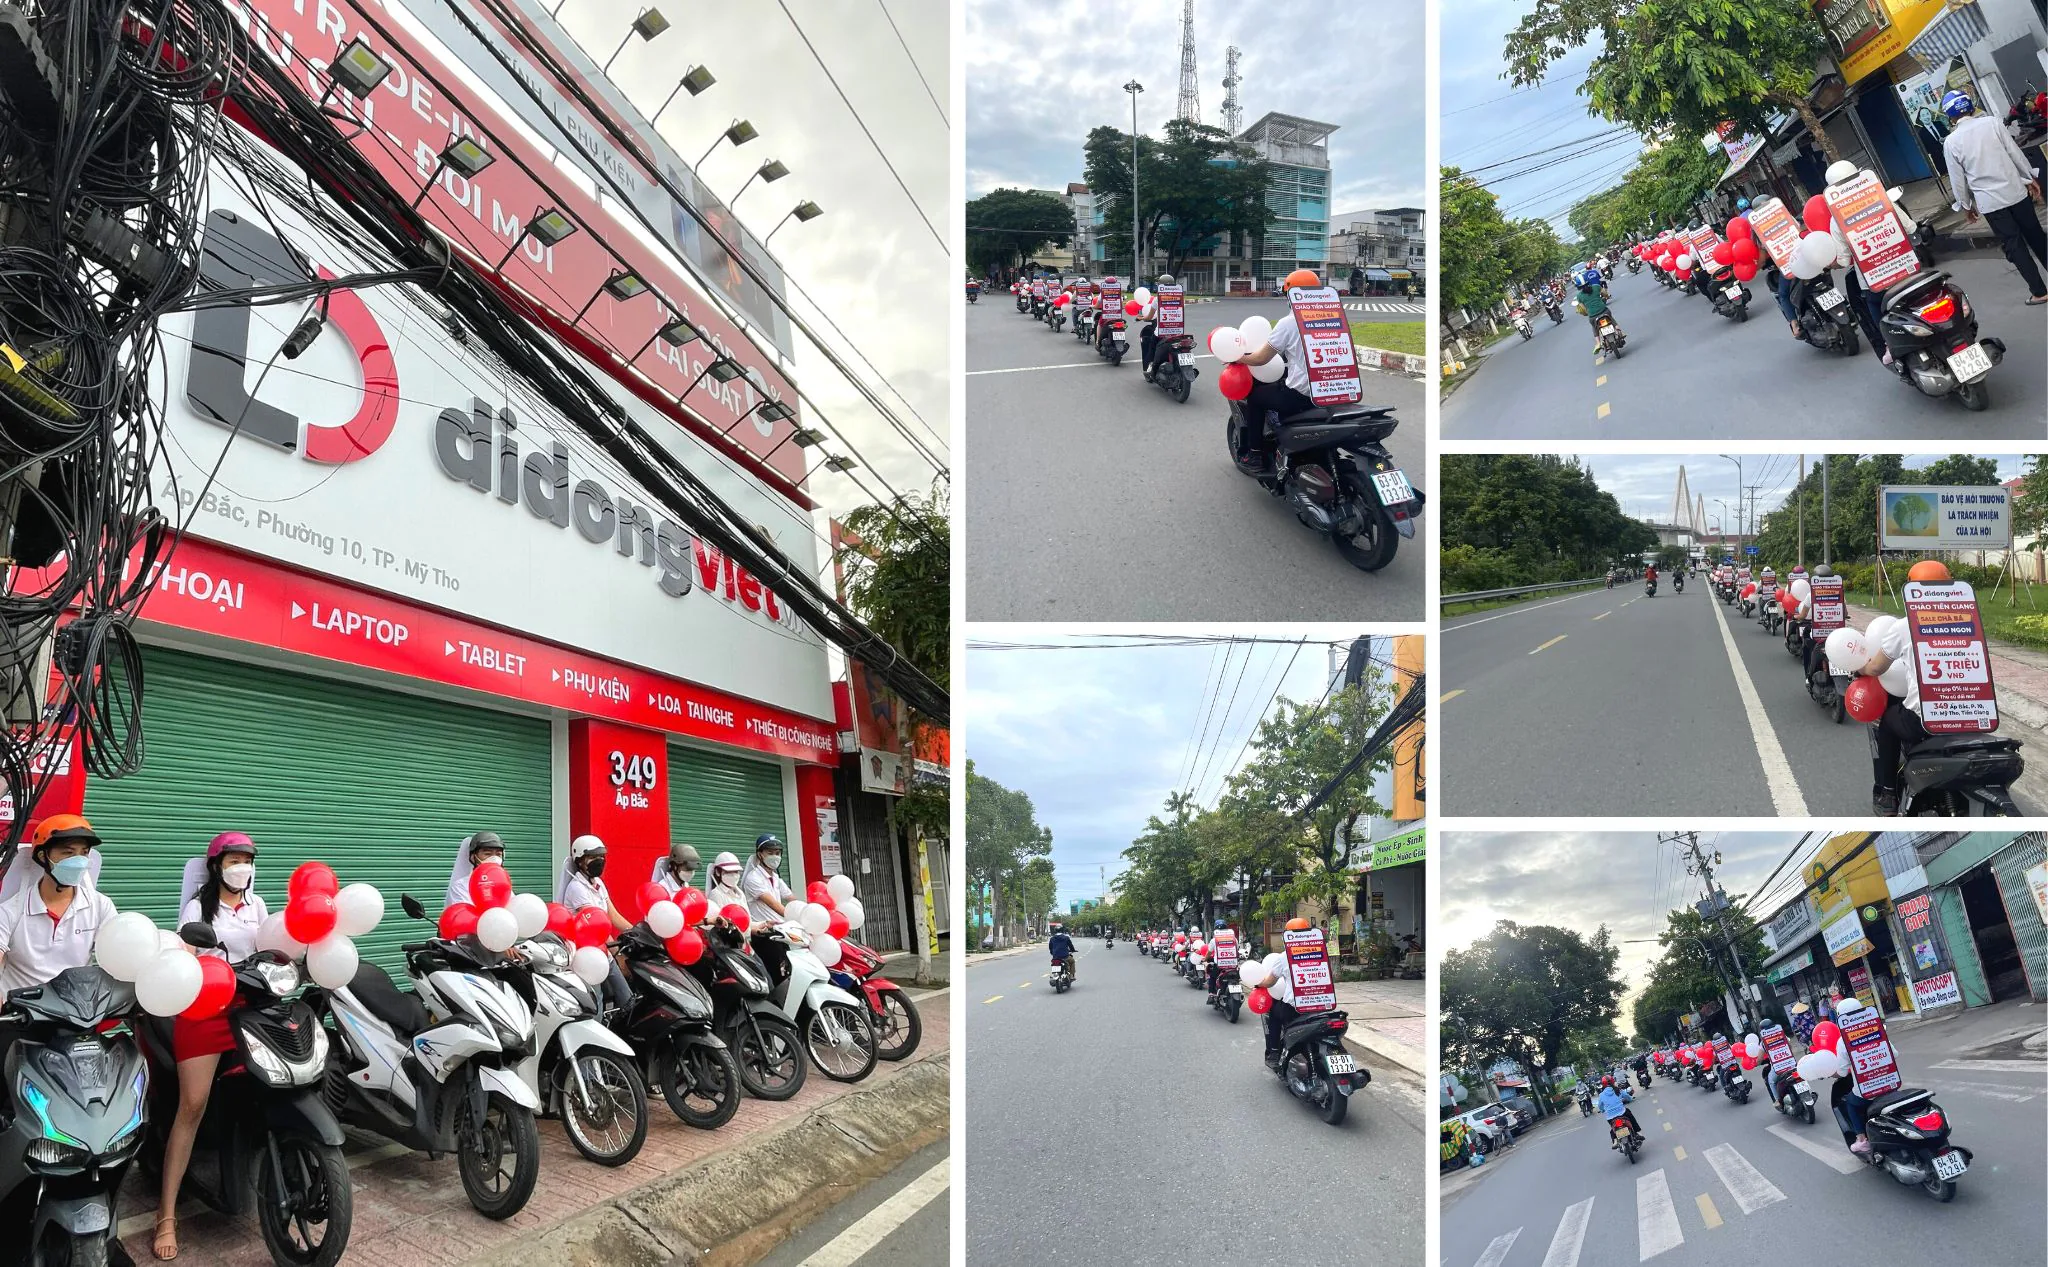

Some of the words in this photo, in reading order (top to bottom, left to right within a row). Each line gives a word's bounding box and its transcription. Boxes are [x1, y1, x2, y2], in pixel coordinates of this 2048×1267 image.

[1840, 178, 1869, 195] didongviet
[1857, 217, 1882, 230] SAMSUNG
[1773, 245, 1784, 256] 3
[1857, 239, 1872, 256] 3
[1870, 227, 1896, 243] TRIỆU
[1311, 348, 1324, 364] 3
[1325, 347, 1349, 357] TRIỆU
[1955, 493, 1964, 506] VỆ
[1978, 509, 1999, 522] NHIỆM
[160, 475, 194, 510] Ấp
[201, 493, 251, 528] Bắc,
[256, 509, 334, 556] Phường
[342, 537, 366, 565] 10,
[372, 547, 399, 573] TP.
[405, 558, 429, 584] Mỹ
[432, 566, 460, 592] Tho
[139, 557, 244, 613] THOẠI
[1924, 589, 1963, 597] didongviet
[1909, 602, 1932, 610] CHÀO
[1933, 602, 1951, 610] TIỀN
[311, 602, 409, 647] LAPTOP
[1816, 611, 1824, 621] 3
[1937, 614, 1953, 622] CHÀ
[1953, 614, 1964, 622] BÁ
[458, 640, 526, 678] TABLET
[1926, 659, 1943, 680] 3
[1945, 658, 1980, 672] TRIỆU
[564, 667, 595, 699] PHỤ
[598, 676, 630, 703] KIỆN
[657, 693, 681, 715] LOA
[1933, 702, 1948, 710] 349
[752, 718, 777, 738] THIẾT
[779, 726, 787, 745] BỊ
[788, 726, 811, 746] CÔNG
[812, 735, 832, 755] NGHỆ
[609, 750, 657, 790] 349
[616, 787, 629, 811] Ấp
[630, 792, 649, 809] Bắc
[1406, 834, 1424, 846] Sinh
[1897, 894, 1929, 918] PHOTO
[1905, 910, 1930, 932] COPY
[1296, 973, 1306, 984] 3
[1914, 972, 1953, 996] PHOTOCOPY
[1330, 1064, 1354, 1073] 133.28
[1857, 1059, 1868, 1070] 3
[1867, 1051, 1888, 1062] TRIỆU
